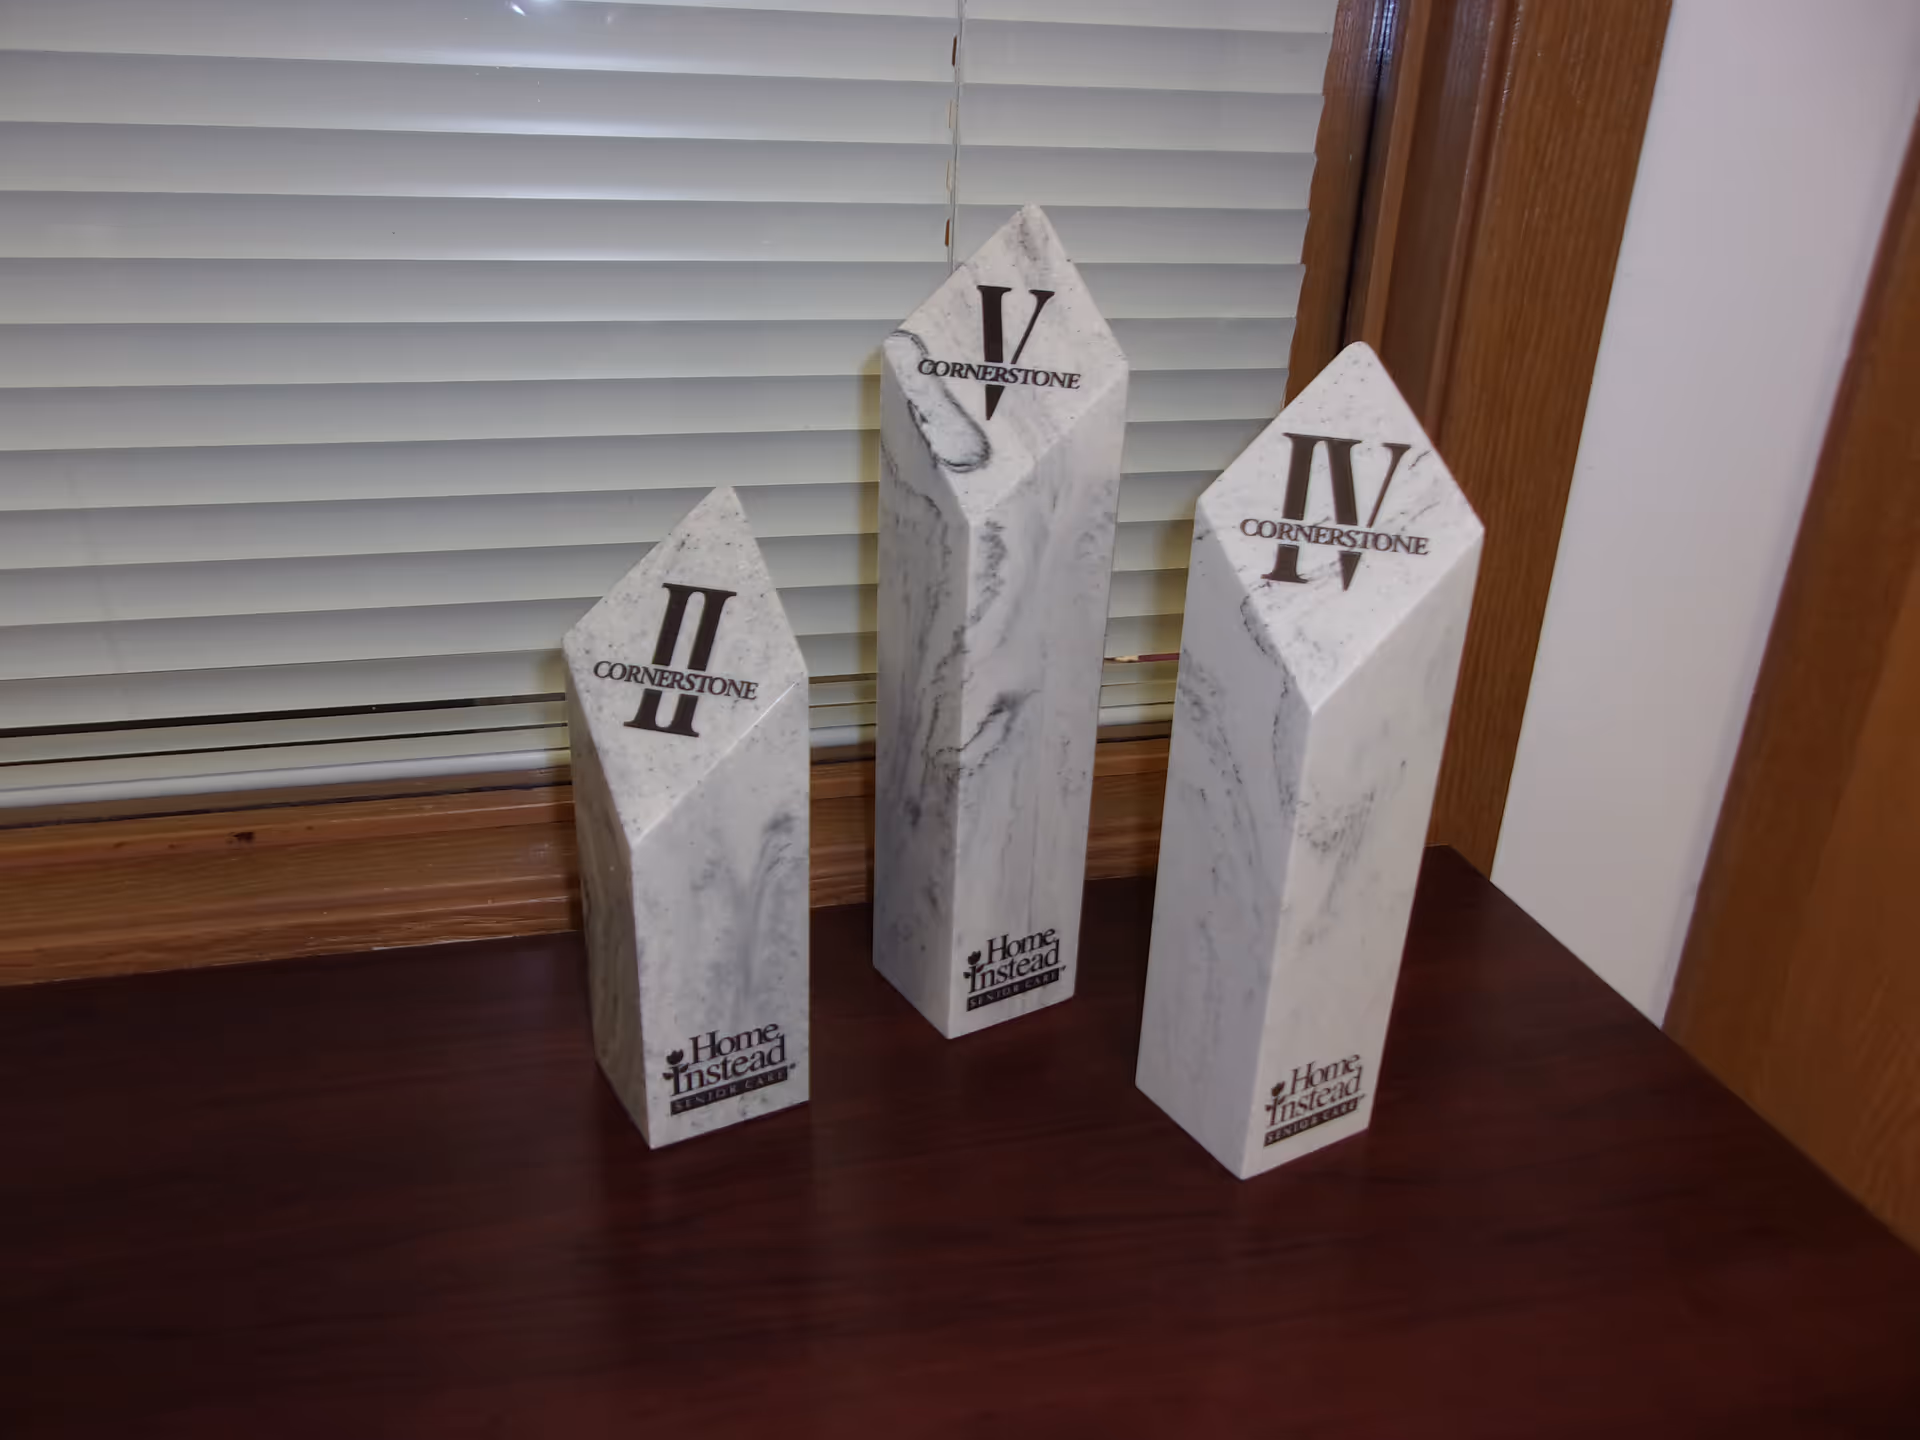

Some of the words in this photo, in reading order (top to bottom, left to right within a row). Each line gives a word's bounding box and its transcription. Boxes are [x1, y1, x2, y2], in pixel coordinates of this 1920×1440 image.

[918, 358, 1081, 389] CORNERSTONE
[977, 285, 1055, 420] V
[1260, 432, 1411, 591] IV
[1240, 518, 1430, 555] CORNERSTONE
[593, 660, 758, 700] CORNERSTONE
[623, 582, 737, 737] II
[968, 938, 1060, 993] Instead
[987, 928, 1056, 963] Home
[669, 1033, 786, 1096] Instead
[689, 1022, 780, 1064] Home
[1267, 1065, 1362, 1128] Instead
[1291, 1054, 1361, 1096] Home
